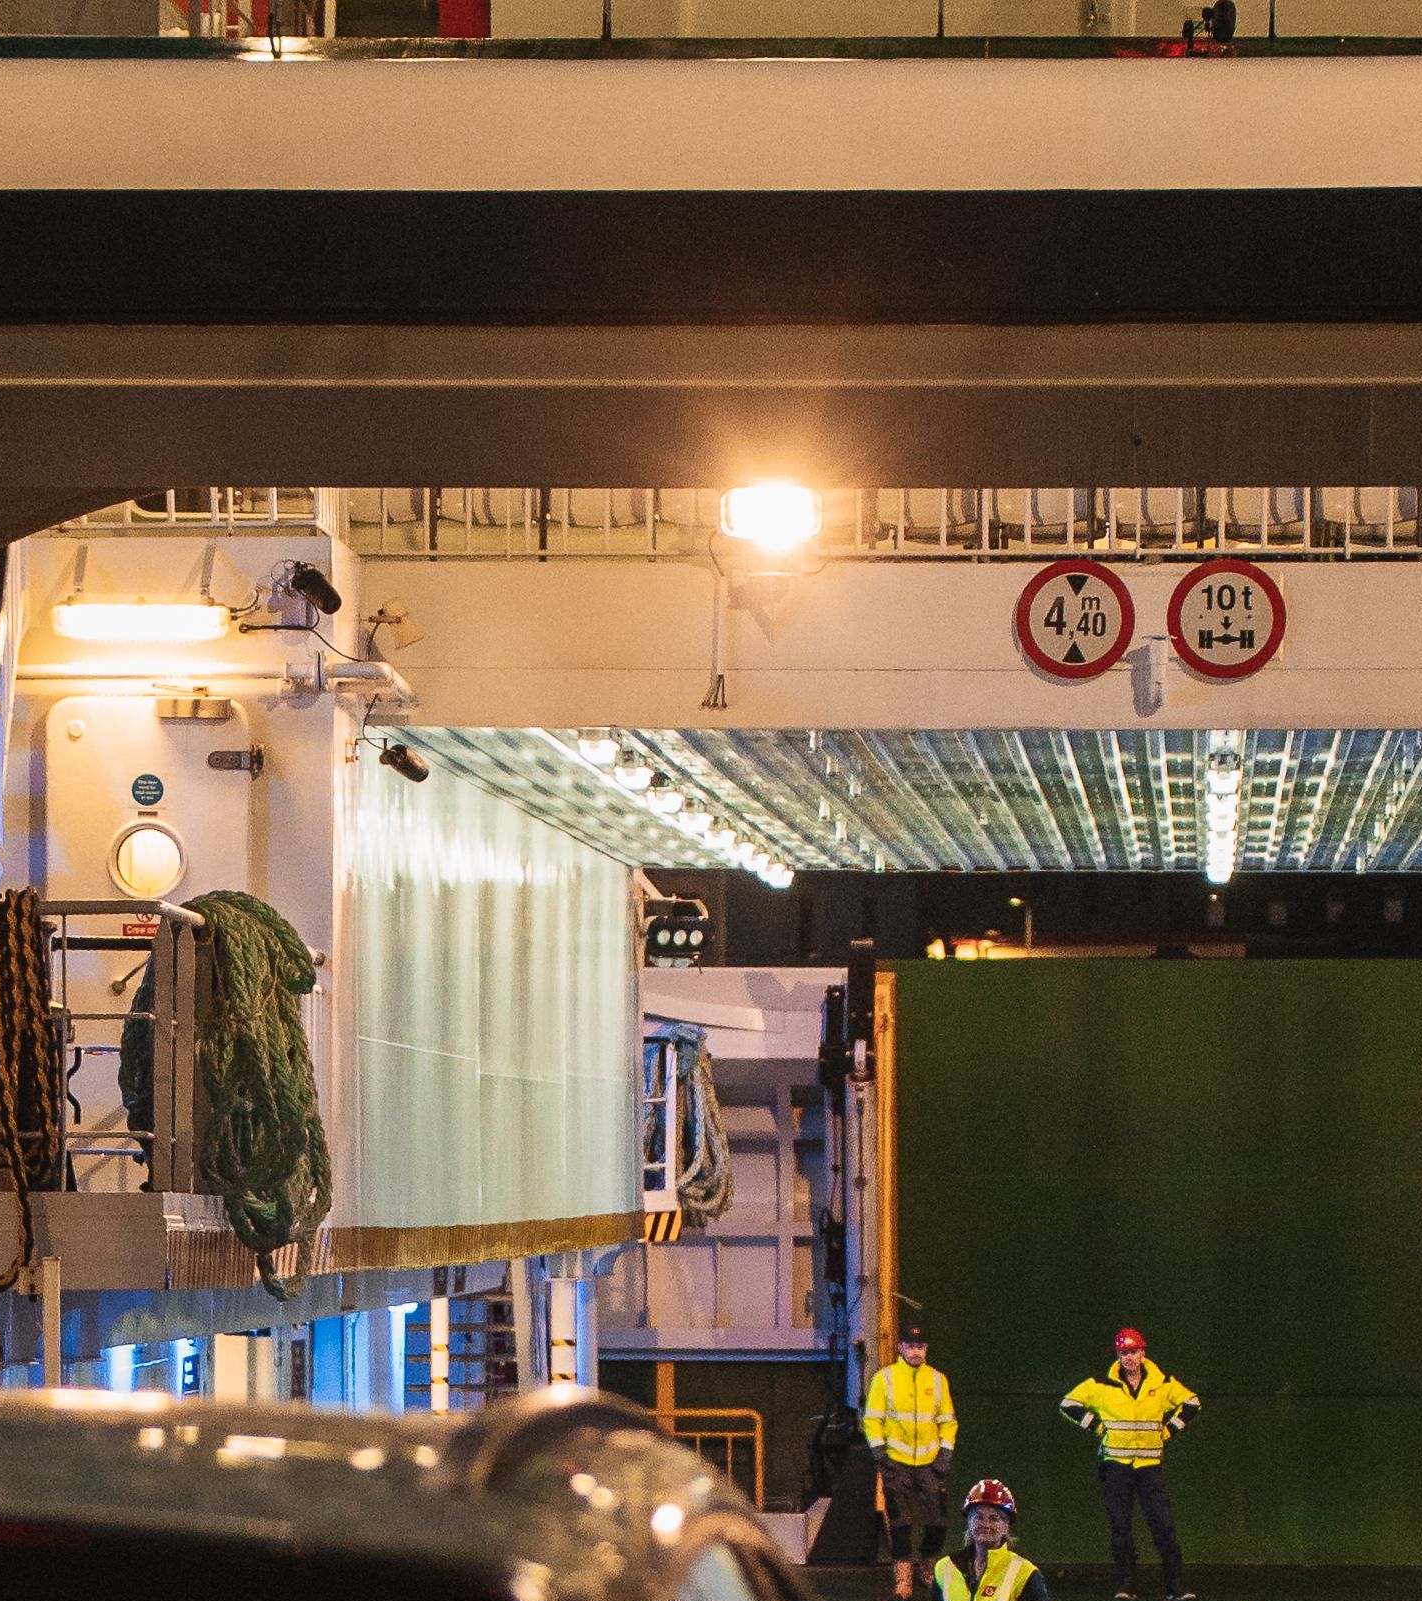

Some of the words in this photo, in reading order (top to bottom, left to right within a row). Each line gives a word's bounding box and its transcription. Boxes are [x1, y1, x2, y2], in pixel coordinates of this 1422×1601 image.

[1081, 596, 1101, 611] m
[1201, 584, 1236, 611] 10
[1241, 585, 1253, 611] t
[127, 925, 146, 935] Crew
